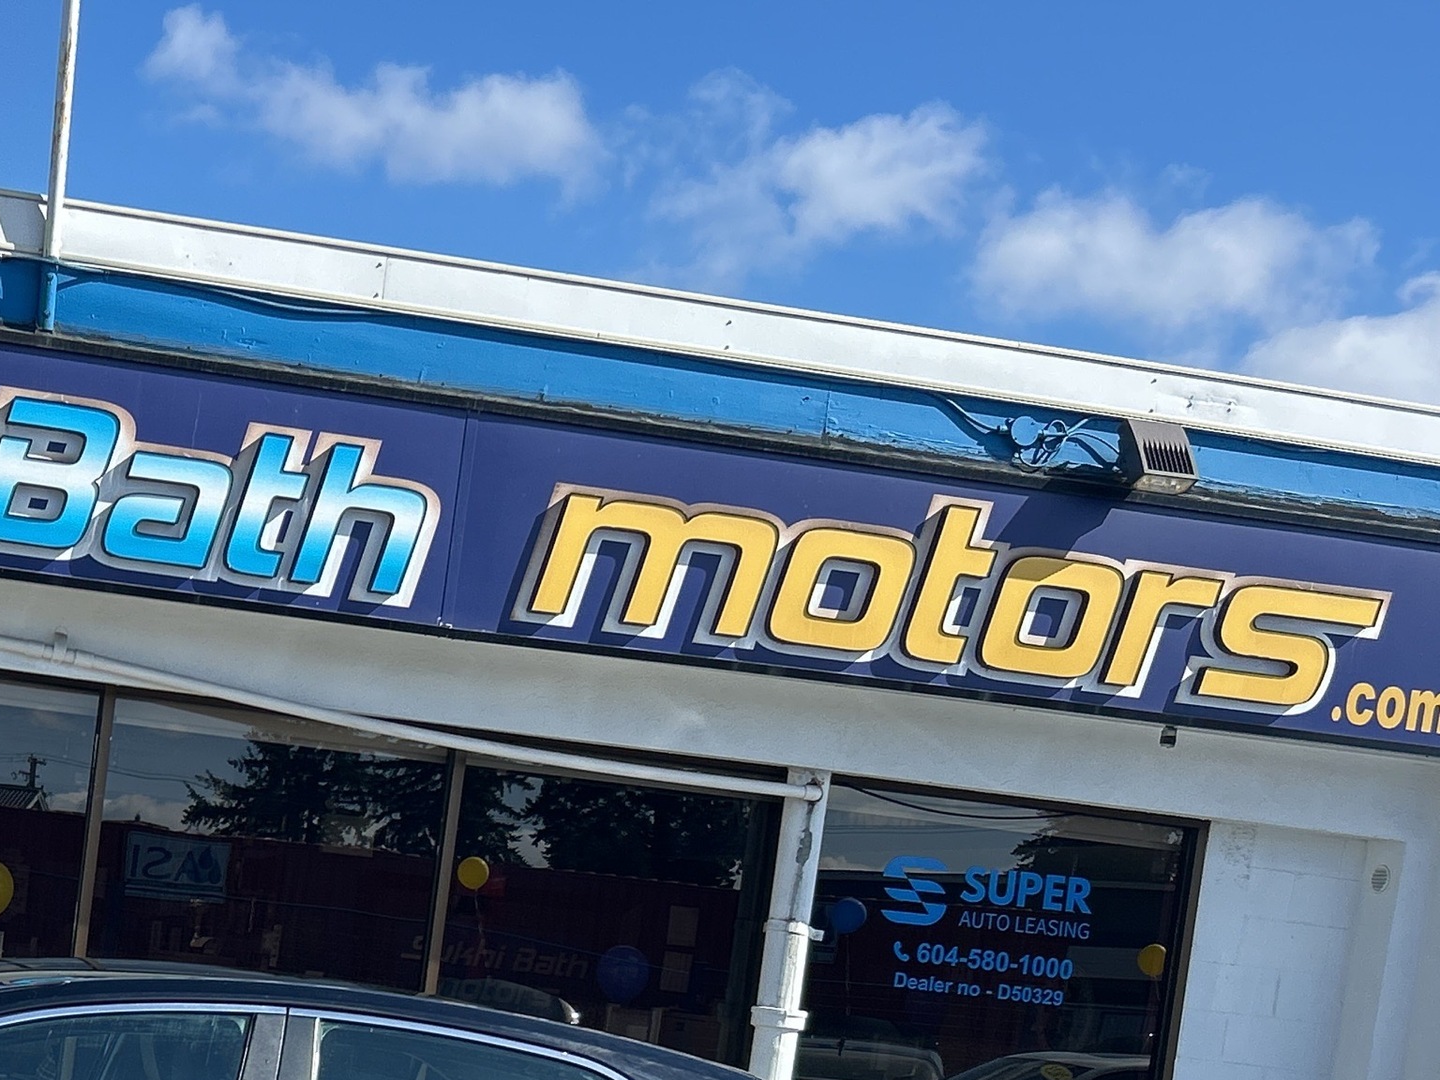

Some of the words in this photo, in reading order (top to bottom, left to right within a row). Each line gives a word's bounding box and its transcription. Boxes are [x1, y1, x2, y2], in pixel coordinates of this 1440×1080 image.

[511, 482, 1392, 716] motors
[1331, 682, 1440, 734] .com
[960, 865, 1092, 914] SUPER
[959, 911, 1010, 932] AUTO
[1014, 916, 1090, 939] LEASING
[513, 947, 589, 979] Bath
[917, 943, 1073, 980] 604-580-1000
[893, 972, 953, 993] Dealer
[957, 983, 980, 996] no
[997, 984, 1064, 1006] D50329
